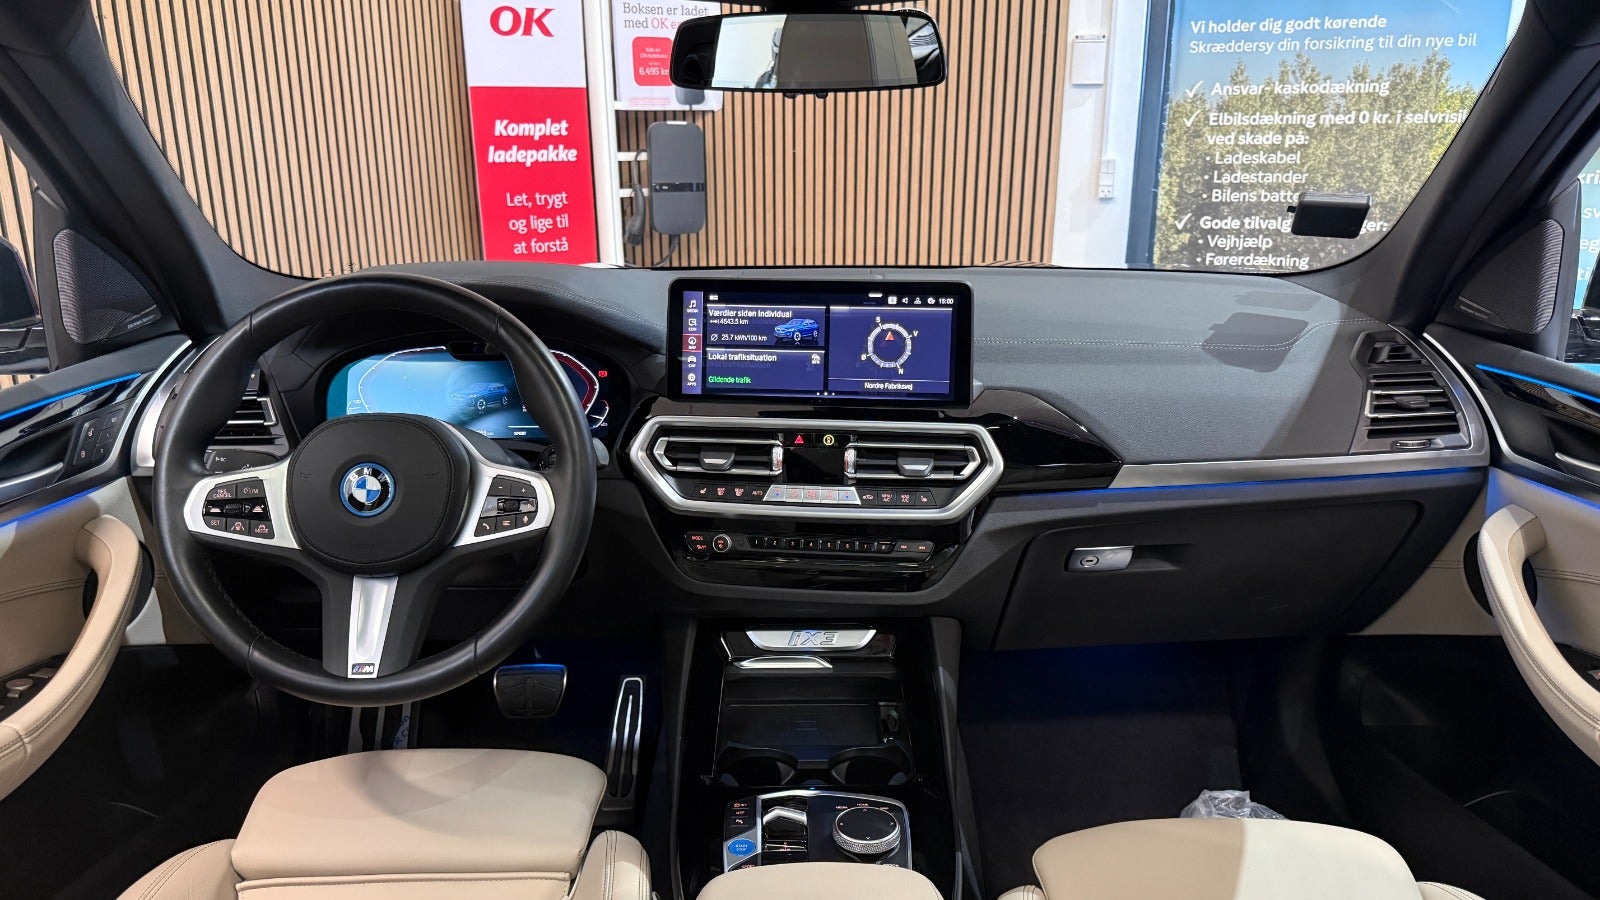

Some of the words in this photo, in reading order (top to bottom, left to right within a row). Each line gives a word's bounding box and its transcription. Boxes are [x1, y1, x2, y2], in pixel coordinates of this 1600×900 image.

[623, 2, 664, 15] Boksen
[666, 6, 678, 16] er
[680, 4, 709, 17] ladet
[490, 6, 556, 37] OK
[624, 18, 648, 29] med
[651, 17, 669, 29] OK
[1191, 20, 1206, 34] Vi
[1208, 19, 1256, 33] holder
[1259, 18, 1283, 34] dig
[1284, 16, 1322, 34] godt
[1324, 15, 1387, 29] kørende
[1189, 40, 1274, 55] Skræddersy
[1277, 38, 1300, 51] din
[1304, 35, 1375, 51] forsikring
[1378, 35, 1394, 48] til
[1397, 34, 1421, 48] din
[1425, 36, 1454, 50] nye
[1458, 33, 1477, 47] bil
[1273, 80, 1390, 96] kaskodækning
[1209, 111, 1317, 128] Elbilsdækning
[1319, 111, 1355, 125] med
[1359, 111, 1369, 124] 0
[1373, 110, 1392, 124] kr.
[1396, 110, 1402, 124] i
[494, 118, 569, 140] Komplet
[1207, 132, 1235, 145] ved
[1238, 132, 1282, 145] skade
[1284, 130, 1310, 147] på:
[488, 145, 578, 167] ladepakke
[1215, 151, 1300, 164] Ladeskabel
[1214, 170, 1308, 183] Ladestander
[506, 192, 532, 208] Let,
[535, 191, 568, 209] trygt
[1212, 189, 1257, 203] Bilens
[509, 219, 528, 234] og
[530, 215, 553, 233] lige
[556, 213, 569, 229] til
[1200, 216, 1241, 230] Gode
[513, 242, 527, 254] at
[531, 236, 569, 253] forstå
[1207, 235, 1273, 250] Vejhjælp
[1205, 253, 1310, 269] Førerdækning
[709, 309, 736, 317] Værdier
[758, 310, 792, 318] Individual
[728, 353, 777, 362] trafiksituation
[736, 376, 751, 384] trafik
[350, 467, 388, 482] BMW
[788, 631, 838, 646] iX3
